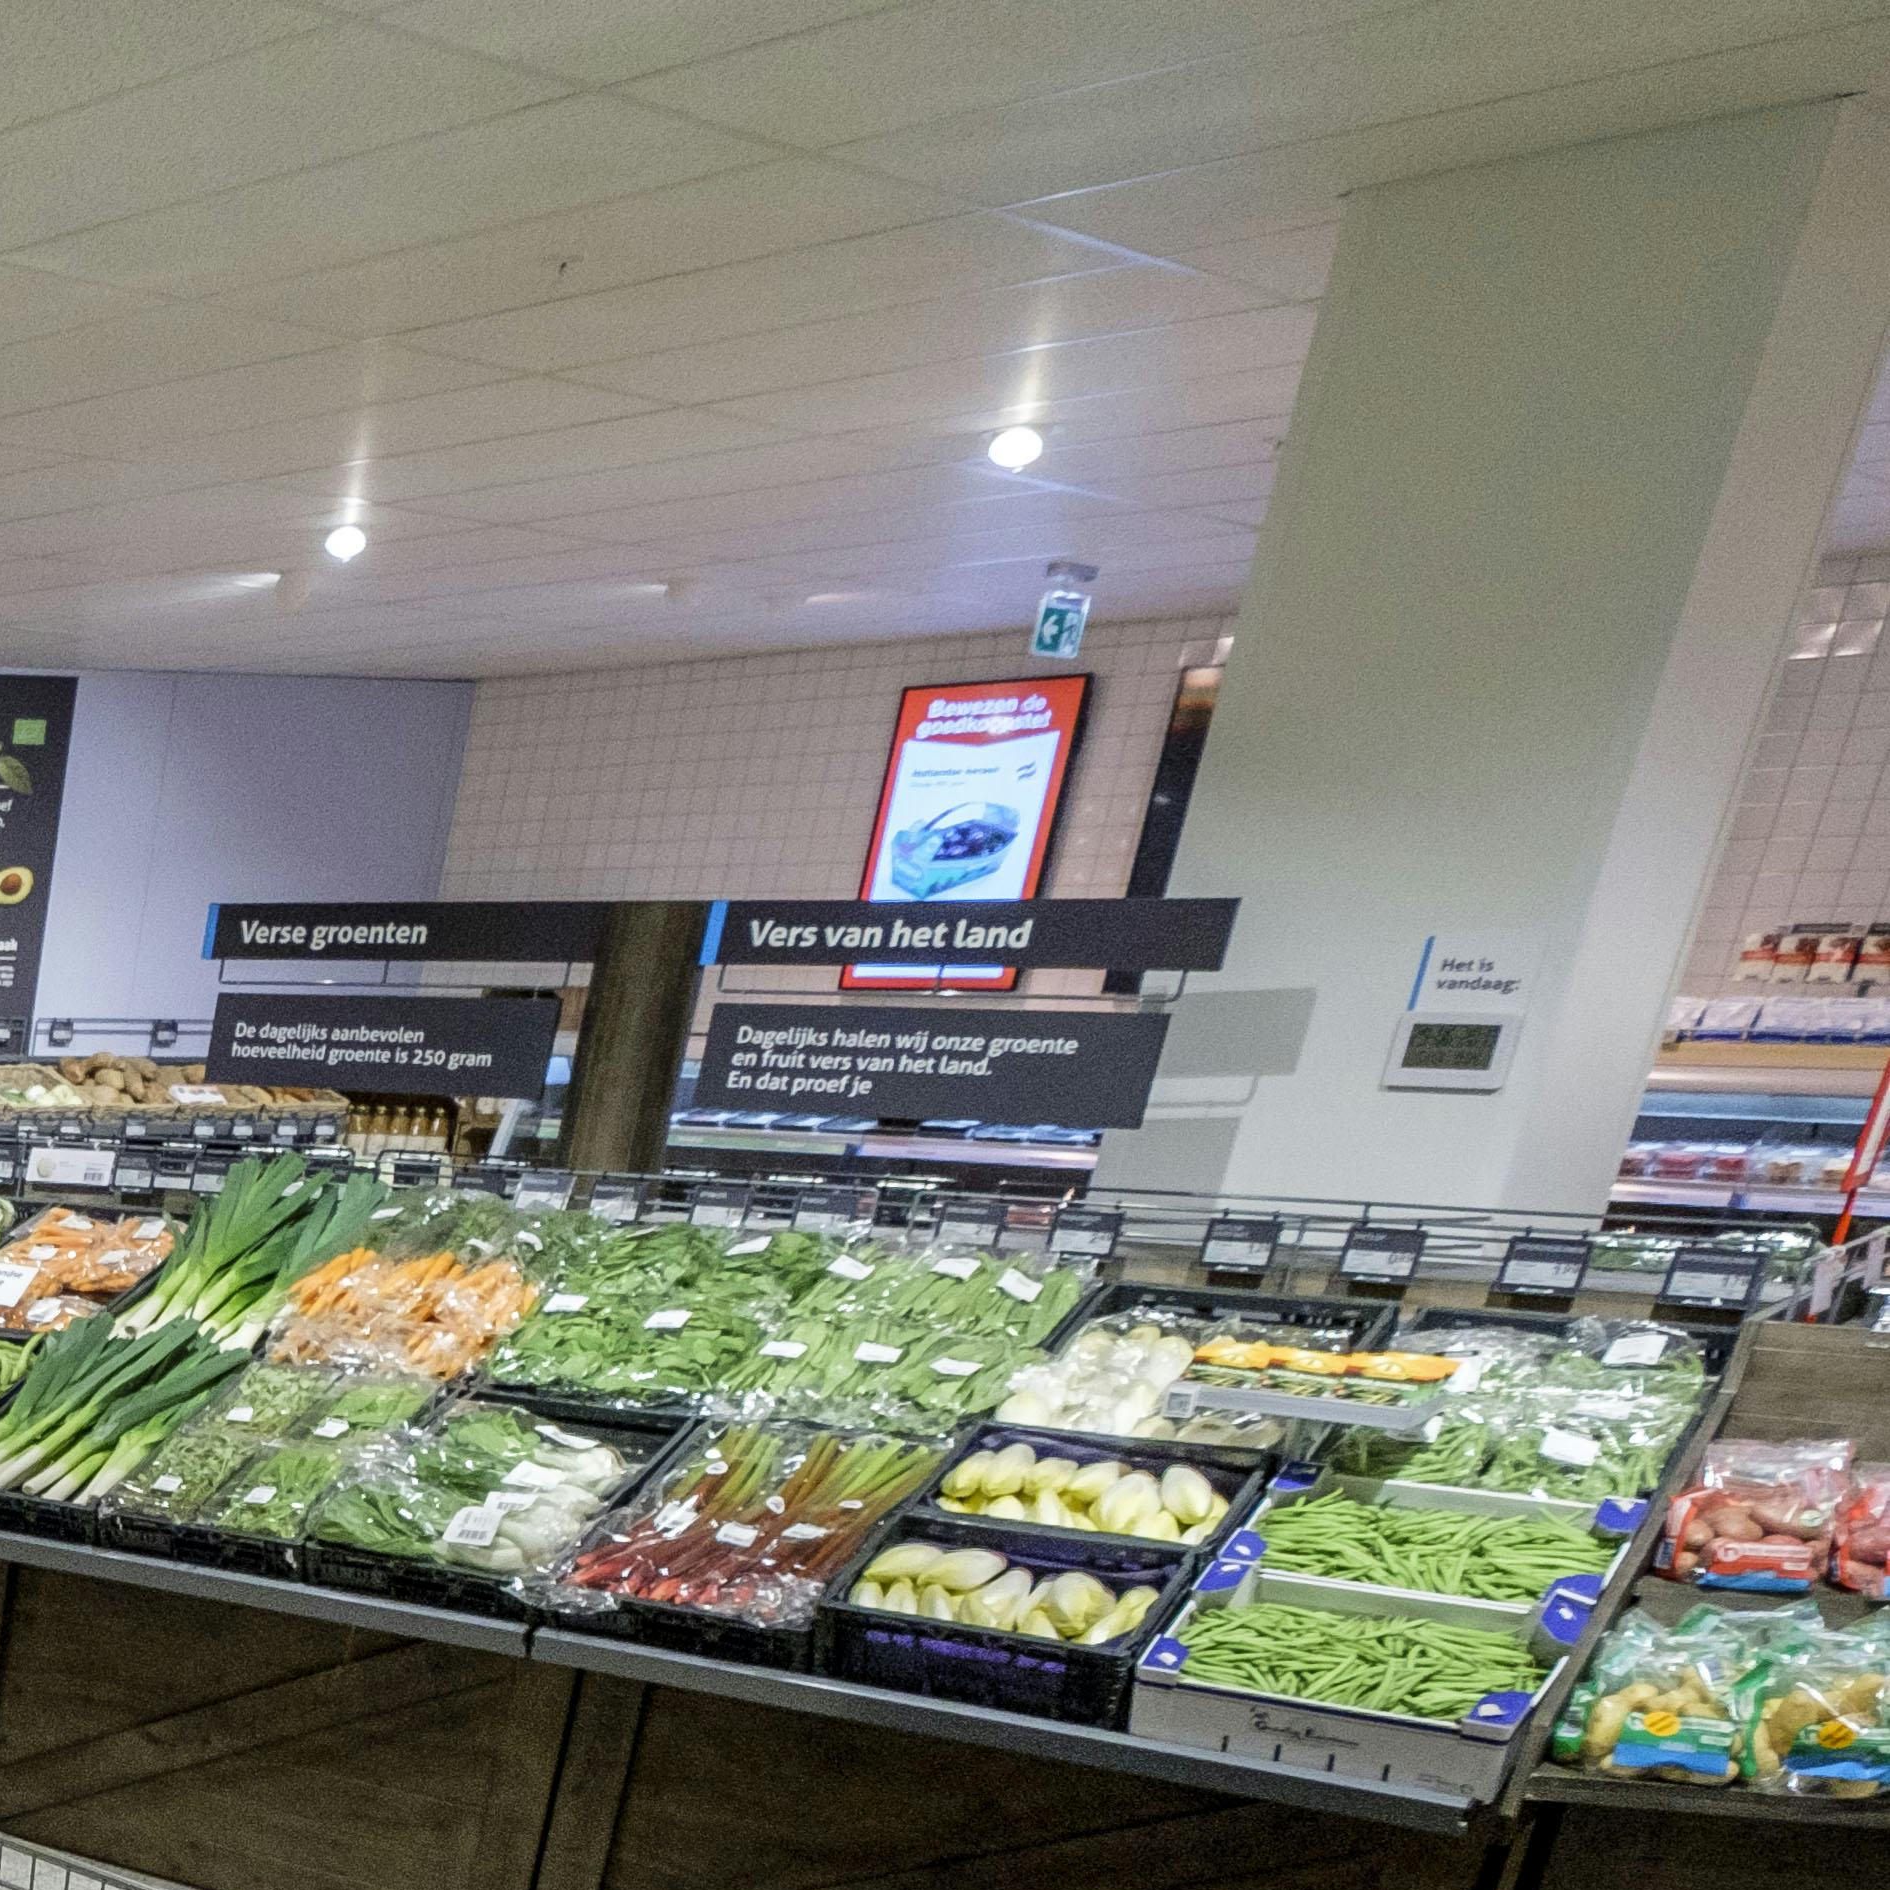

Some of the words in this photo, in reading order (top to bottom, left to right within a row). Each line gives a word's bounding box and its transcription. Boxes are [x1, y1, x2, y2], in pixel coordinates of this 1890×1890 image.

[927, 697, 1019, 719] Bewezen
[1022, 693, 1048, 713] de
[240, 920, 307, 945] Verse
[310, 924, 428, 951] groenten
[749, 919, 818, 949] Vers
[824, 926, 881, 949] van
[889, 918, 947, 949] het
[953, 919, 1035, 949] land
[1440, 958, 1474, 972] Het
[1478, 956, 1495, 972] is
[234, 1022, 256, 1039] De
[259, 1022, 328, 1043] dagelijks
[331, 1026, 425, 1044] aanbevolen
[736, 1025, 829, 1051] Dagelijks
[832, 1029, 891, 1050] halen
[895, 1031, 929, 1054] wij
[932, 1034, 984, 1052] onze
[986, 1036, 1079, 1059] groente
[231, 1041, 326, 1062] hoeveelheid
[327, 1046, 391, 1066] groente
[394, 1047, 409, 1064] is
[412, 1049, 446, 1067] 250
[448, 1052, 492, 1071] gram
[731, 1051, 758, 1067] en
[762, 1049, 806, 1069] fruit
[808, 1053, 852, 1072] vers
[856, 1056, 894, 1073] van
[899, 1055, 935, 1074] het
[938, 1055, 993, 1077] land.
[726, 1071, 753, 1090] En
[755, 1073, 788, 1092] dat
[789, 1073, 847, 1097] proef
[848, 1076, 873, 1098] je
